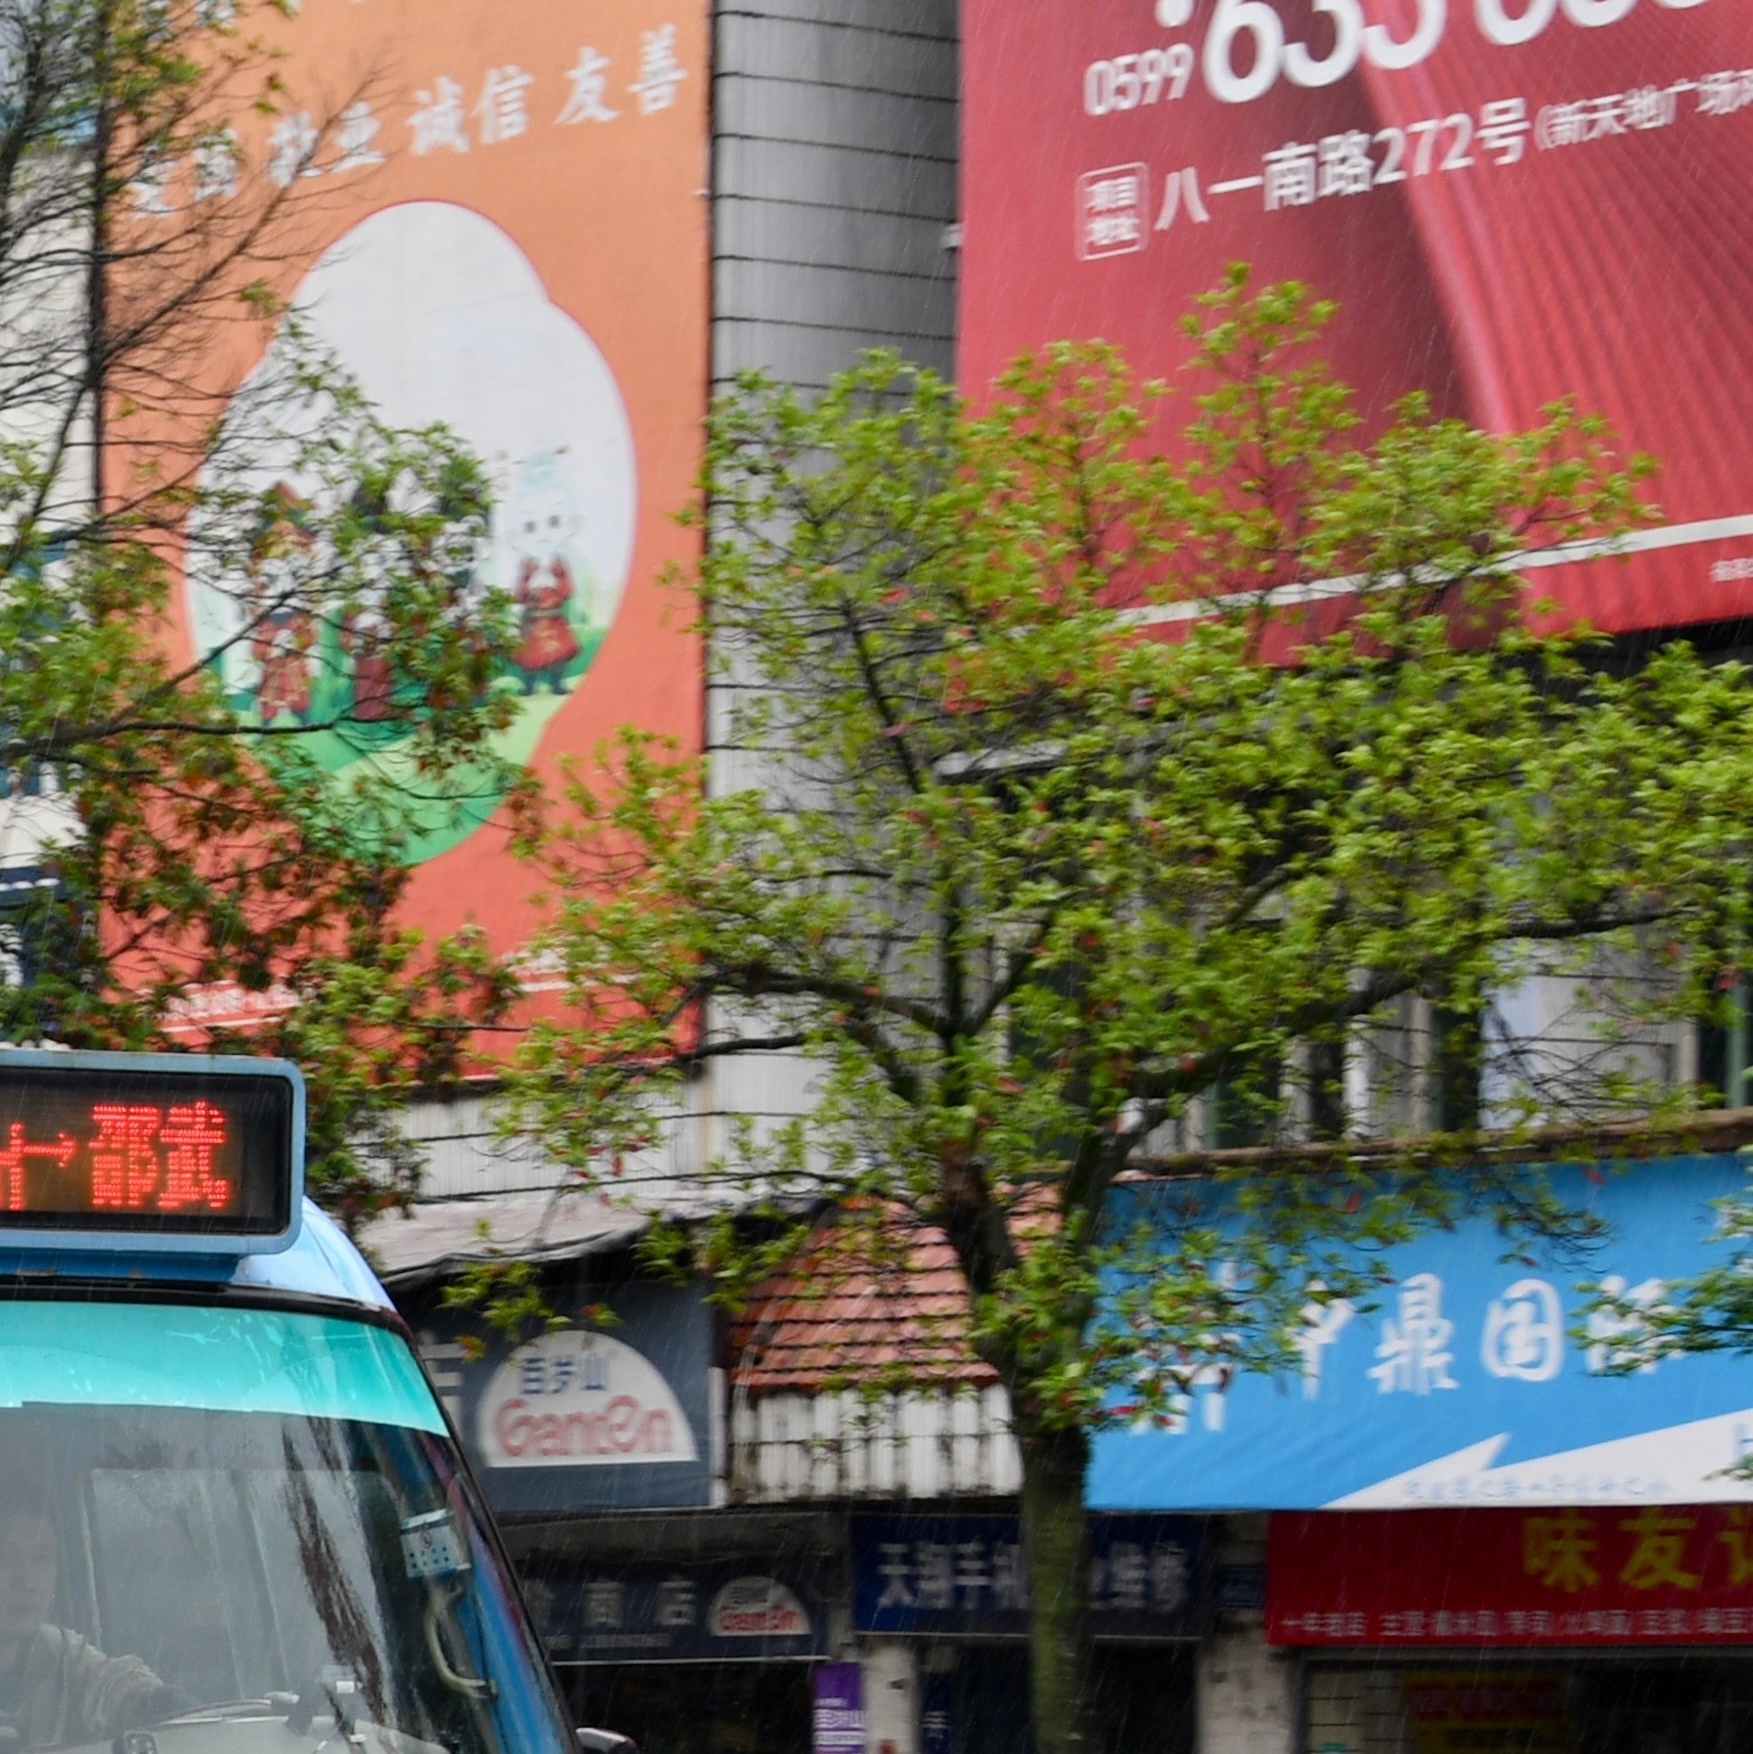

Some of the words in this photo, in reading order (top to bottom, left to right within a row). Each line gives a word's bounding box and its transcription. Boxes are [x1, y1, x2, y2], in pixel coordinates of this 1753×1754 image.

[1084, 43, 1193, 116] 0599
[1153, 97, 1532, 231] 八一南路272号
[496, 1394, 673, 1457] Ganten
